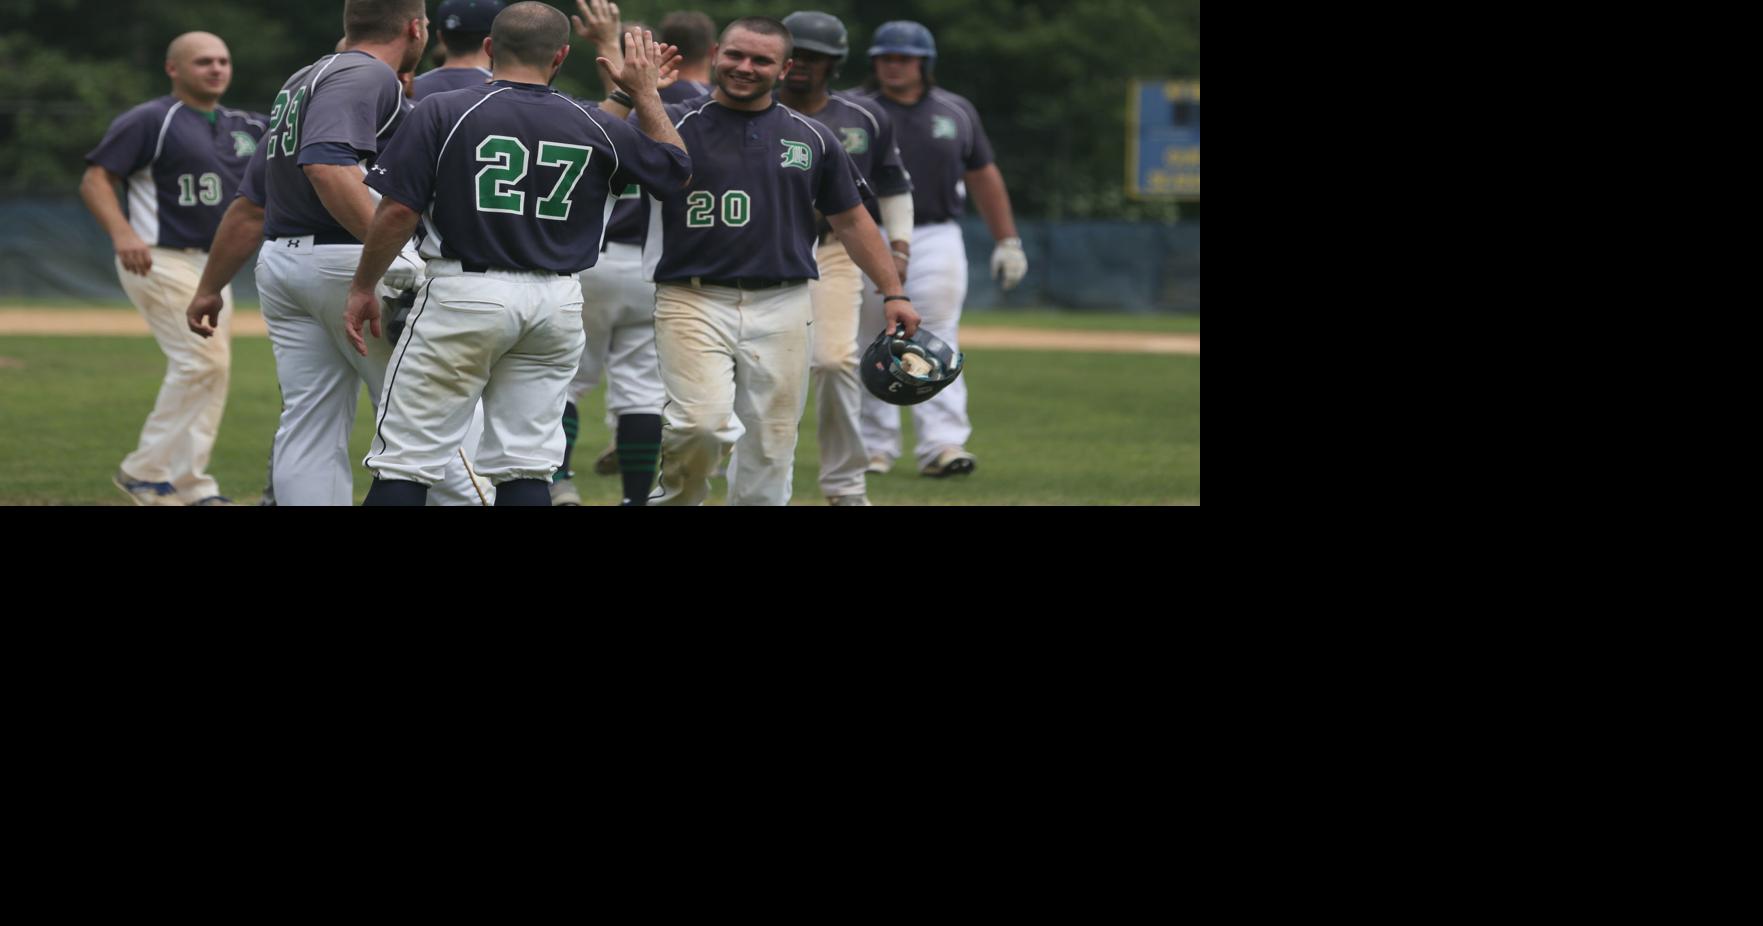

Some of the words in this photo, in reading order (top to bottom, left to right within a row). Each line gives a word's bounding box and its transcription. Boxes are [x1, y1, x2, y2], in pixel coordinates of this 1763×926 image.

[267, 85, 307, 160] 29
[780, 138, 813, 172] D
[178, 172, 223, 206] 13
[475, 134, 593, 221] 27
[686, 189, 751, 228] 20
